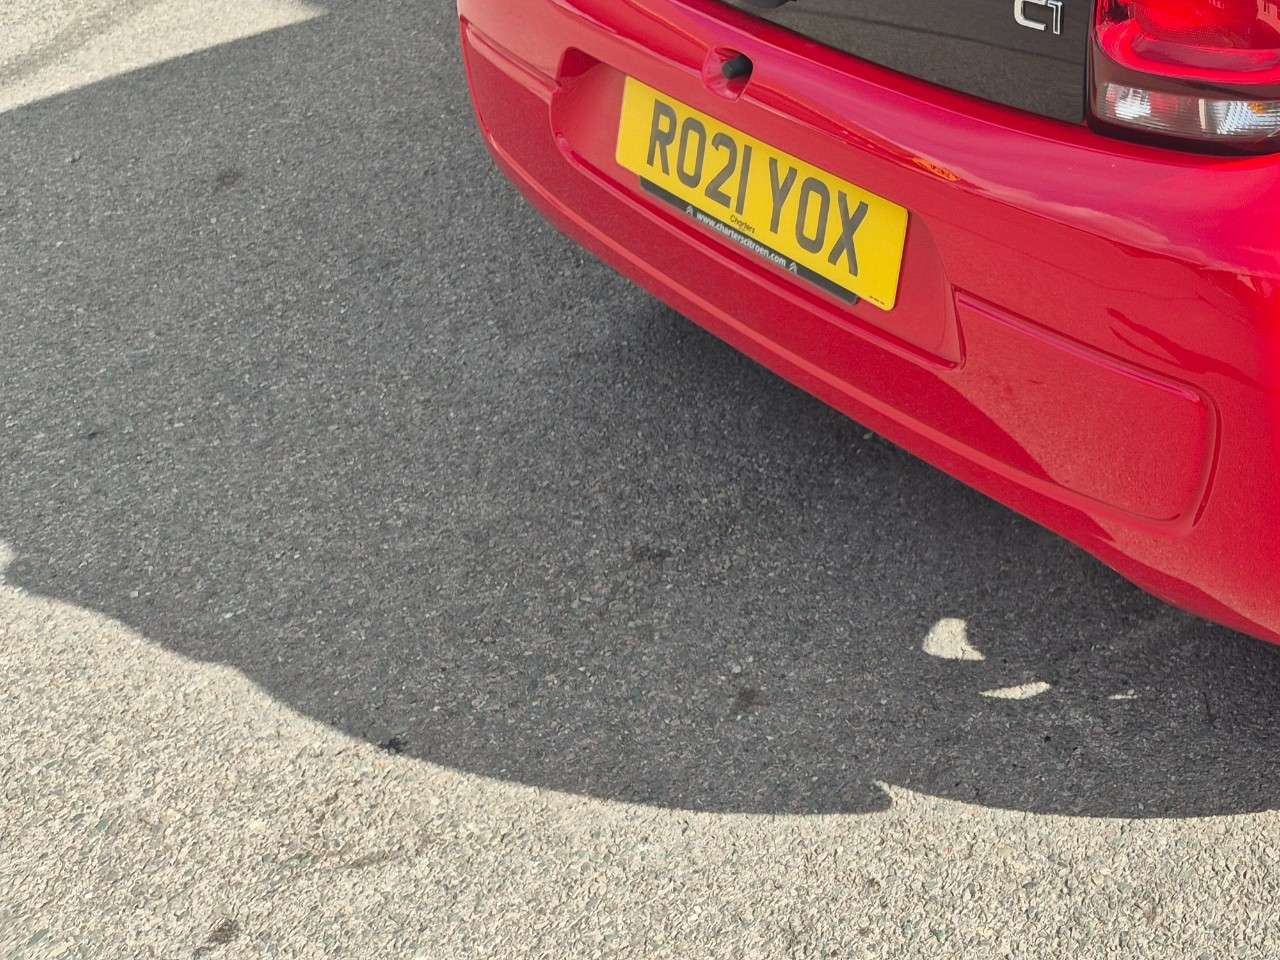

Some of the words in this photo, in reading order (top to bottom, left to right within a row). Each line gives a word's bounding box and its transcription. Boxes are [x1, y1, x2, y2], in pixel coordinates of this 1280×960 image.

[646, 98, 753, 216] RO21
[768, 156, 869, 277] YOX
[696, 211, 787, 268] www.charterscitroen.com
